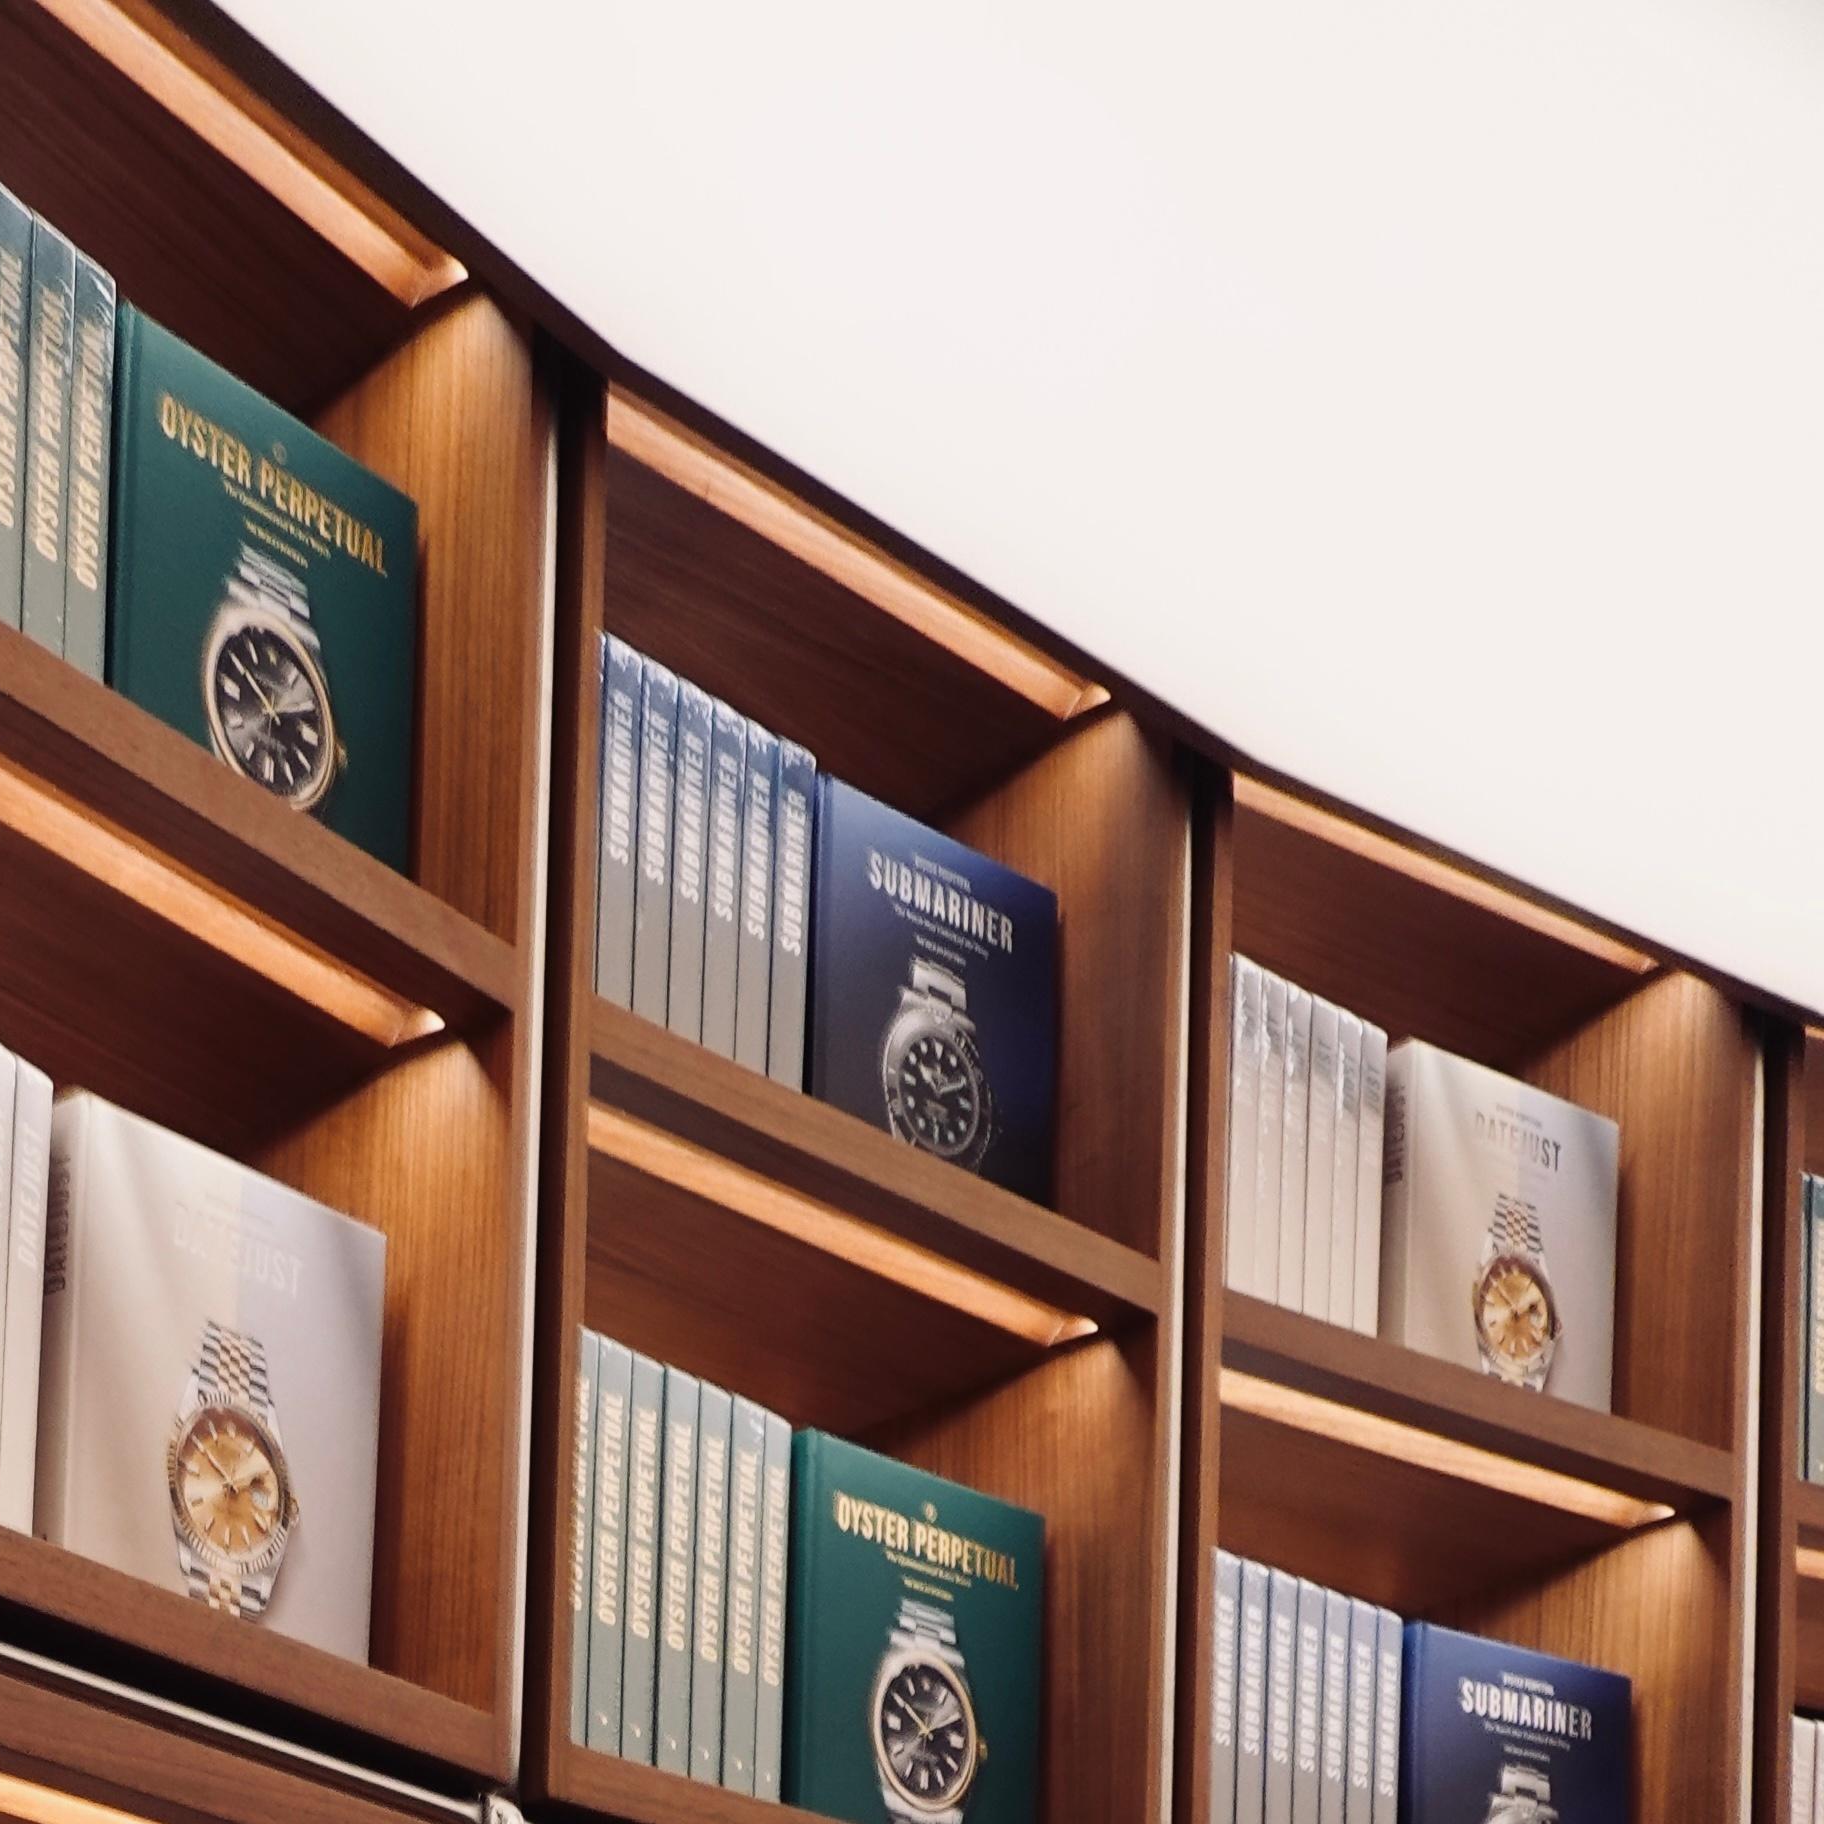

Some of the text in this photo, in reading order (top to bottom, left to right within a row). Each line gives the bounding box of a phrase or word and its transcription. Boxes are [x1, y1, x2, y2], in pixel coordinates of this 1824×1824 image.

[34, 284, 67, 562] OYSTER PERPETUAL
[72, 318, 106, 591] OYSTER PERPETUAL
[158, 392, 252, 489] OYSTER
[256, 457, 388, 578] PERPETUAL
[609, 691, 633, 866] SUBMARINER
[644, 710, 671, 886] SUBMARINER
[679, 731, 705, 904] SUBMARINER
[714, 751, 740, 923] SUBMARINER
[747, 770, 770, 941] SUBMARINER
[780, 788, 807, 956] SUBMARINER
[868, 850, 1012, 953] SUBMARINER
[16, 1117, 43, 1267] DATEJUST
[1476, 1110, 1561, 1172] DATEJUST
[597, 1392, 623, 1626] OYSTER PERPETUAL
[632, 1407, 657, 1639] OYSTER PERPETUAL
[667, 1421, 692, 1652] OYSTER PERPETUAL
[700, 1434, 725, 1663] OYSTER PERPETUAL
[733, 1449, 758, 1675] OYSTER PERPETUAL
[763, 1467, 785, 1687] OYSTER PERPETUAL
[834, 1490, 910, 1553] OYSTER
[911, 1516, 1019, 1591] PERPETUAL
[1215, 1597, 1236, 1746] SUBMARINER
[1244, 1606, 1263, 1757] SUBMARINER
[1273, 1616, 1293, 1764] SUBMARINER
[1300, 1624, 1319, 1773] SUBMARINER
[1327, 1634, 1345, 1783] SUBMARINER
[1353, 1641, 1373, 1790] SUBMARINER
[1380, 1652, 1397, 1798] SUBMARINER
[1459, 1677, 1592, 1741] SUBMARINER
